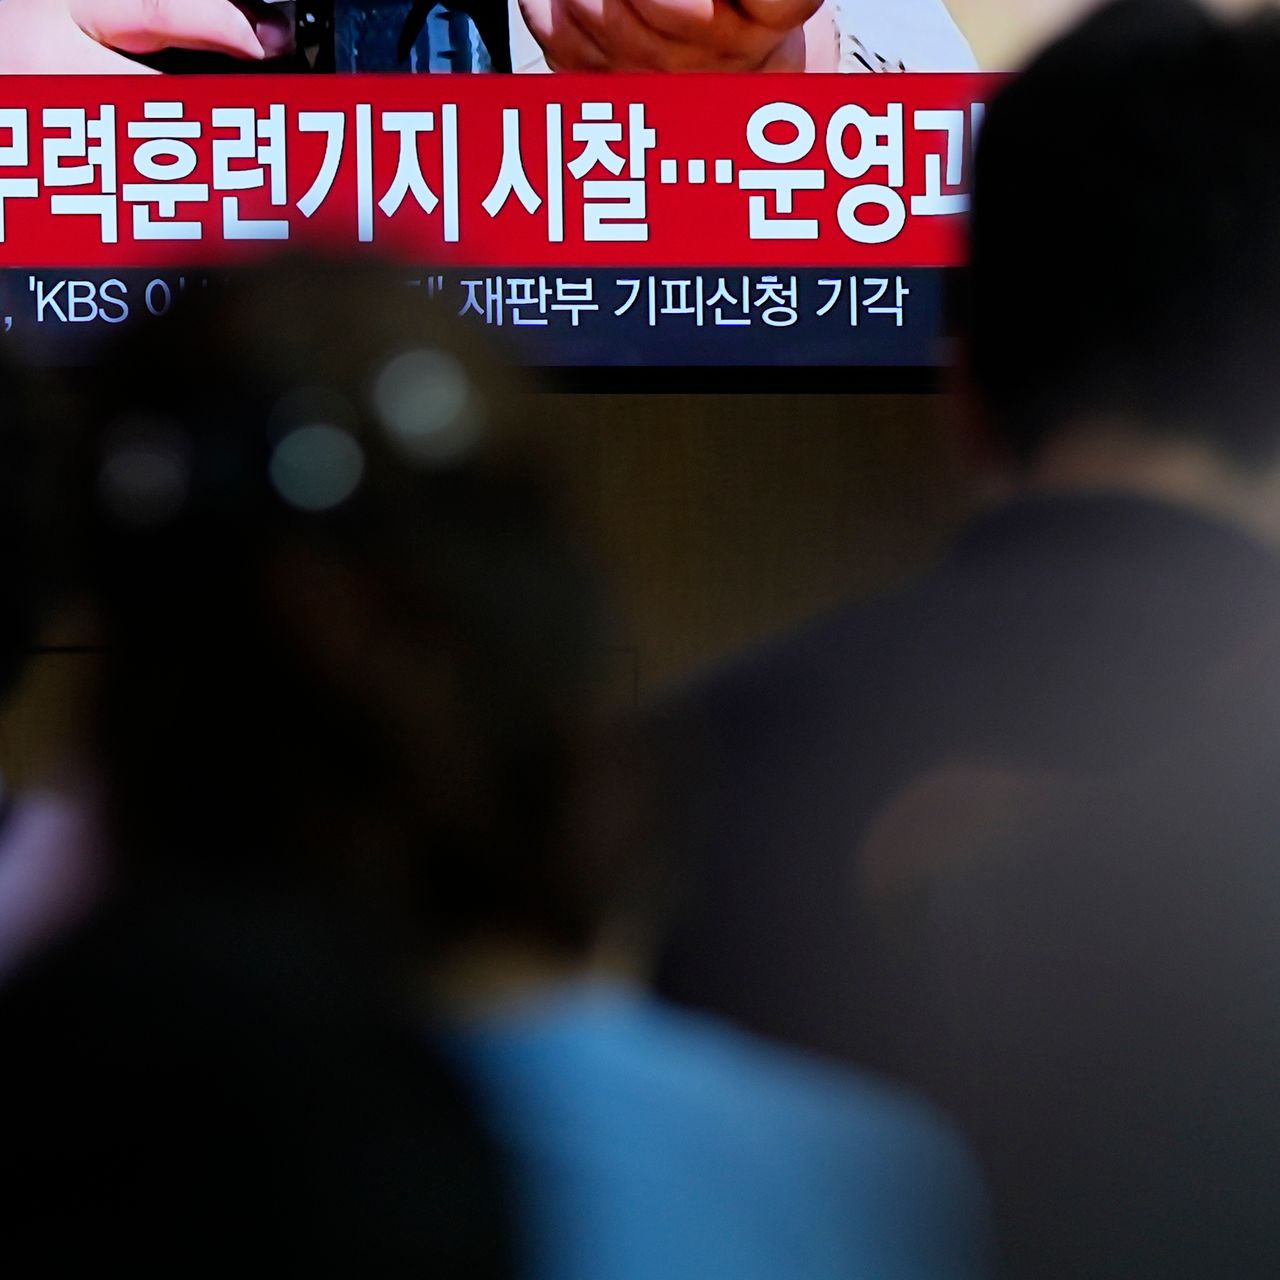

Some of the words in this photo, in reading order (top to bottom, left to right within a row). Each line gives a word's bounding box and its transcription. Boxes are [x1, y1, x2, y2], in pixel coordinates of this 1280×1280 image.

[459, 275, 599, 327] 재판부
[614, 275, 799, 327] 기피신청
[816, 275, 910, 327] 기각
